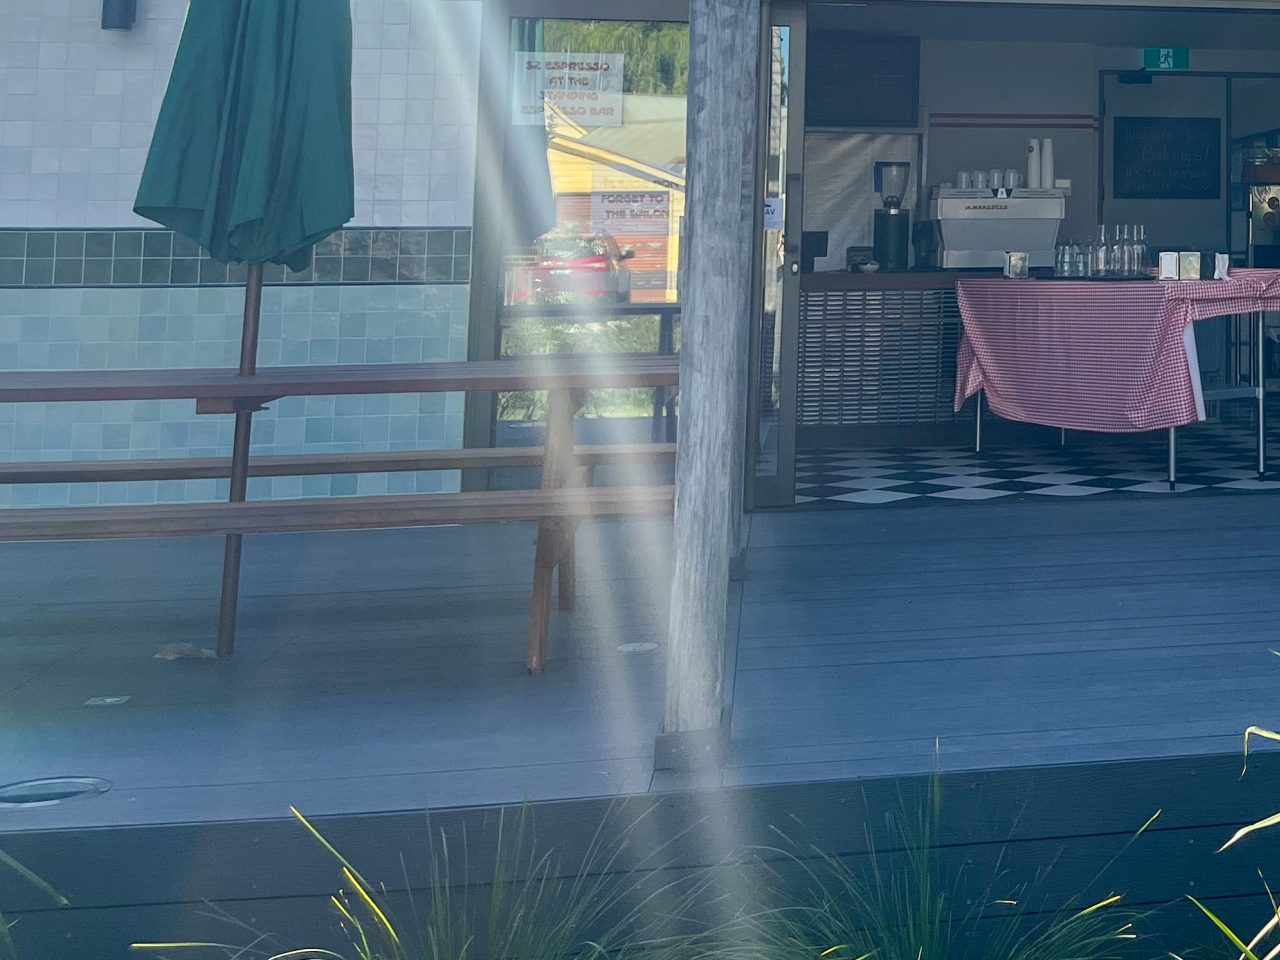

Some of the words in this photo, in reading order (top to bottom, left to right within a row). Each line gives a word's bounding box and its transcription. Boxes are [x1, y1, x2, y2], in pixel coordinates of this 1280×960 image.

[545, 61, 610, 72] ESPRESSO
[549, 76, 564, 86] AT
[568, 76, 589, 86] THE
[539, 91, 599, 101] STANDING
[590, 107, 615, 116] BAR
[602, 194, 646, 204] FORGET
[649, 194, 664, 204] TO
